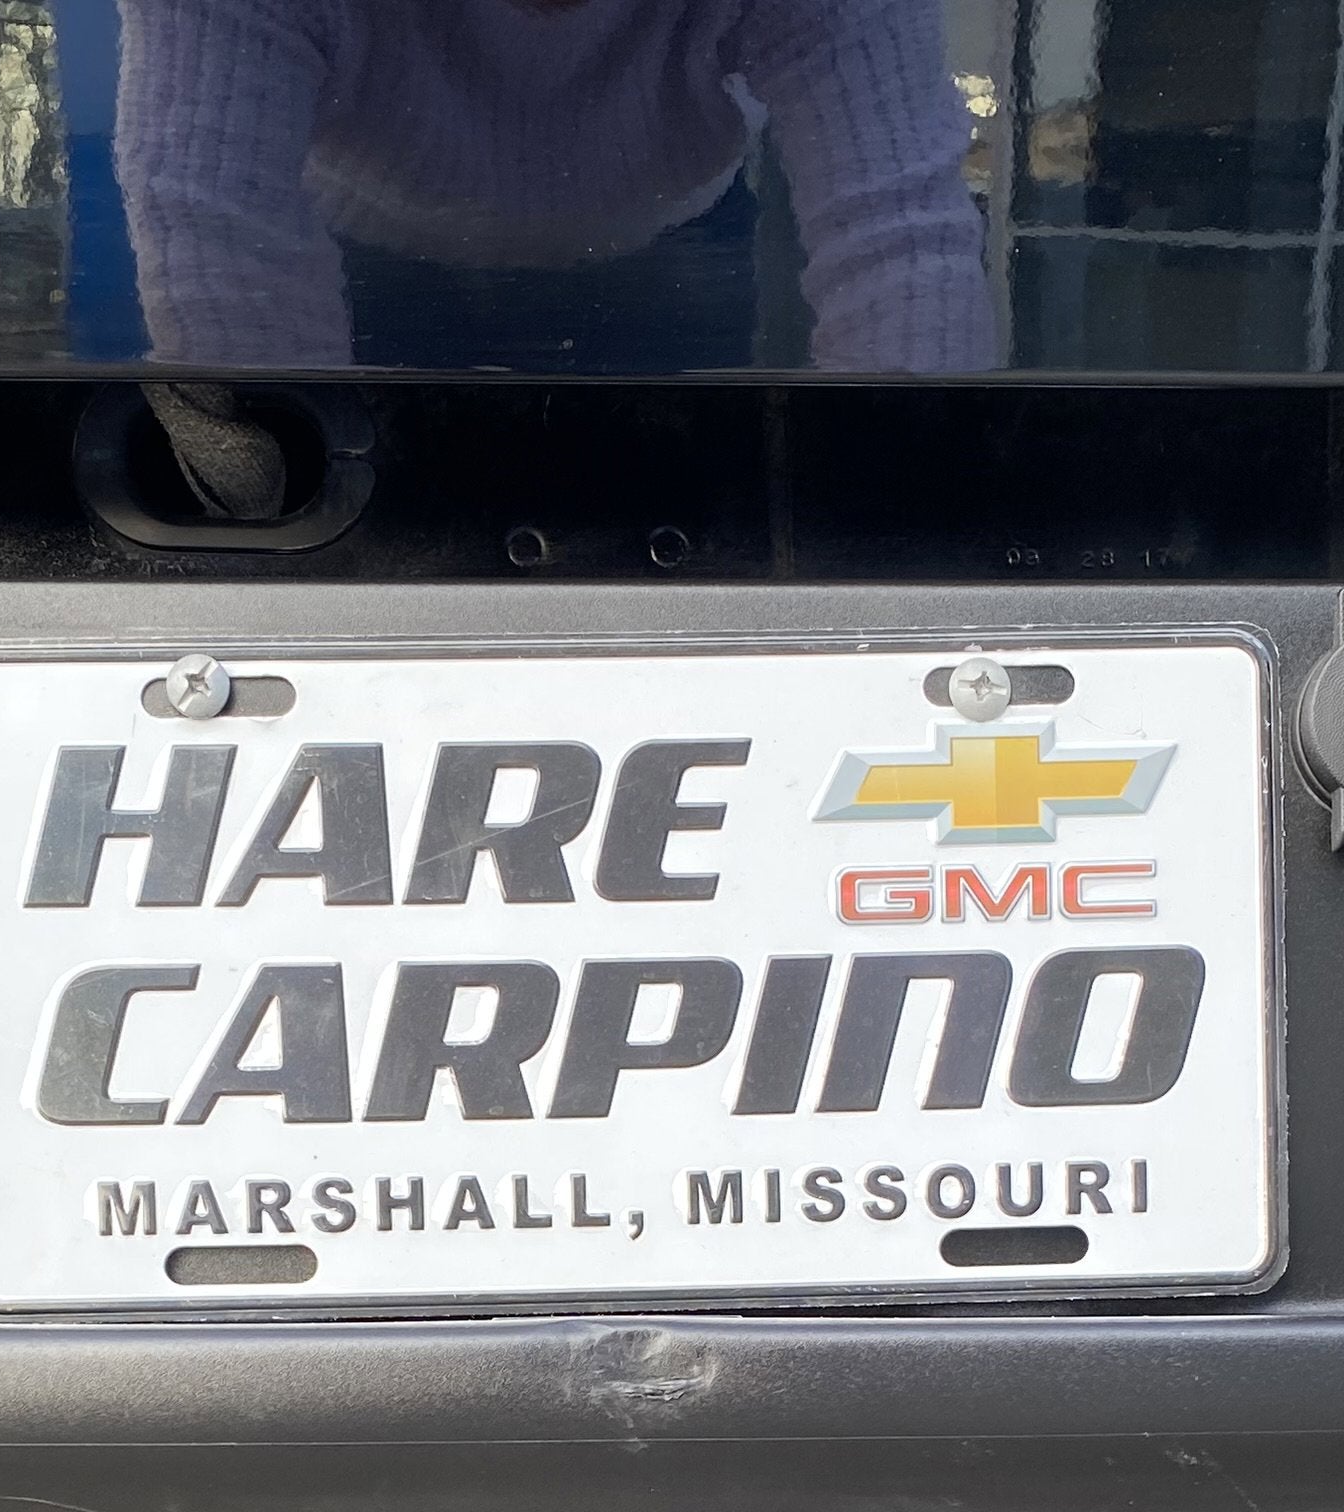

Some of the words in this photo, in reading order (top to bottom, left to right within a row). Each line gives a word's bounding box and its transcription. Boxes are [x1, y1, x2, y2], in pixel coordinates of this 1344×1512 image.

[22, 737, 753, 908] HARE
[836, 859, 1159, 926] GMC
[35, 944, 1208, 1127] CARPINO
[96, 1171, 645, 1242] MARSHALL,
[685, 1160, 1151, 1229] MISSOURI
